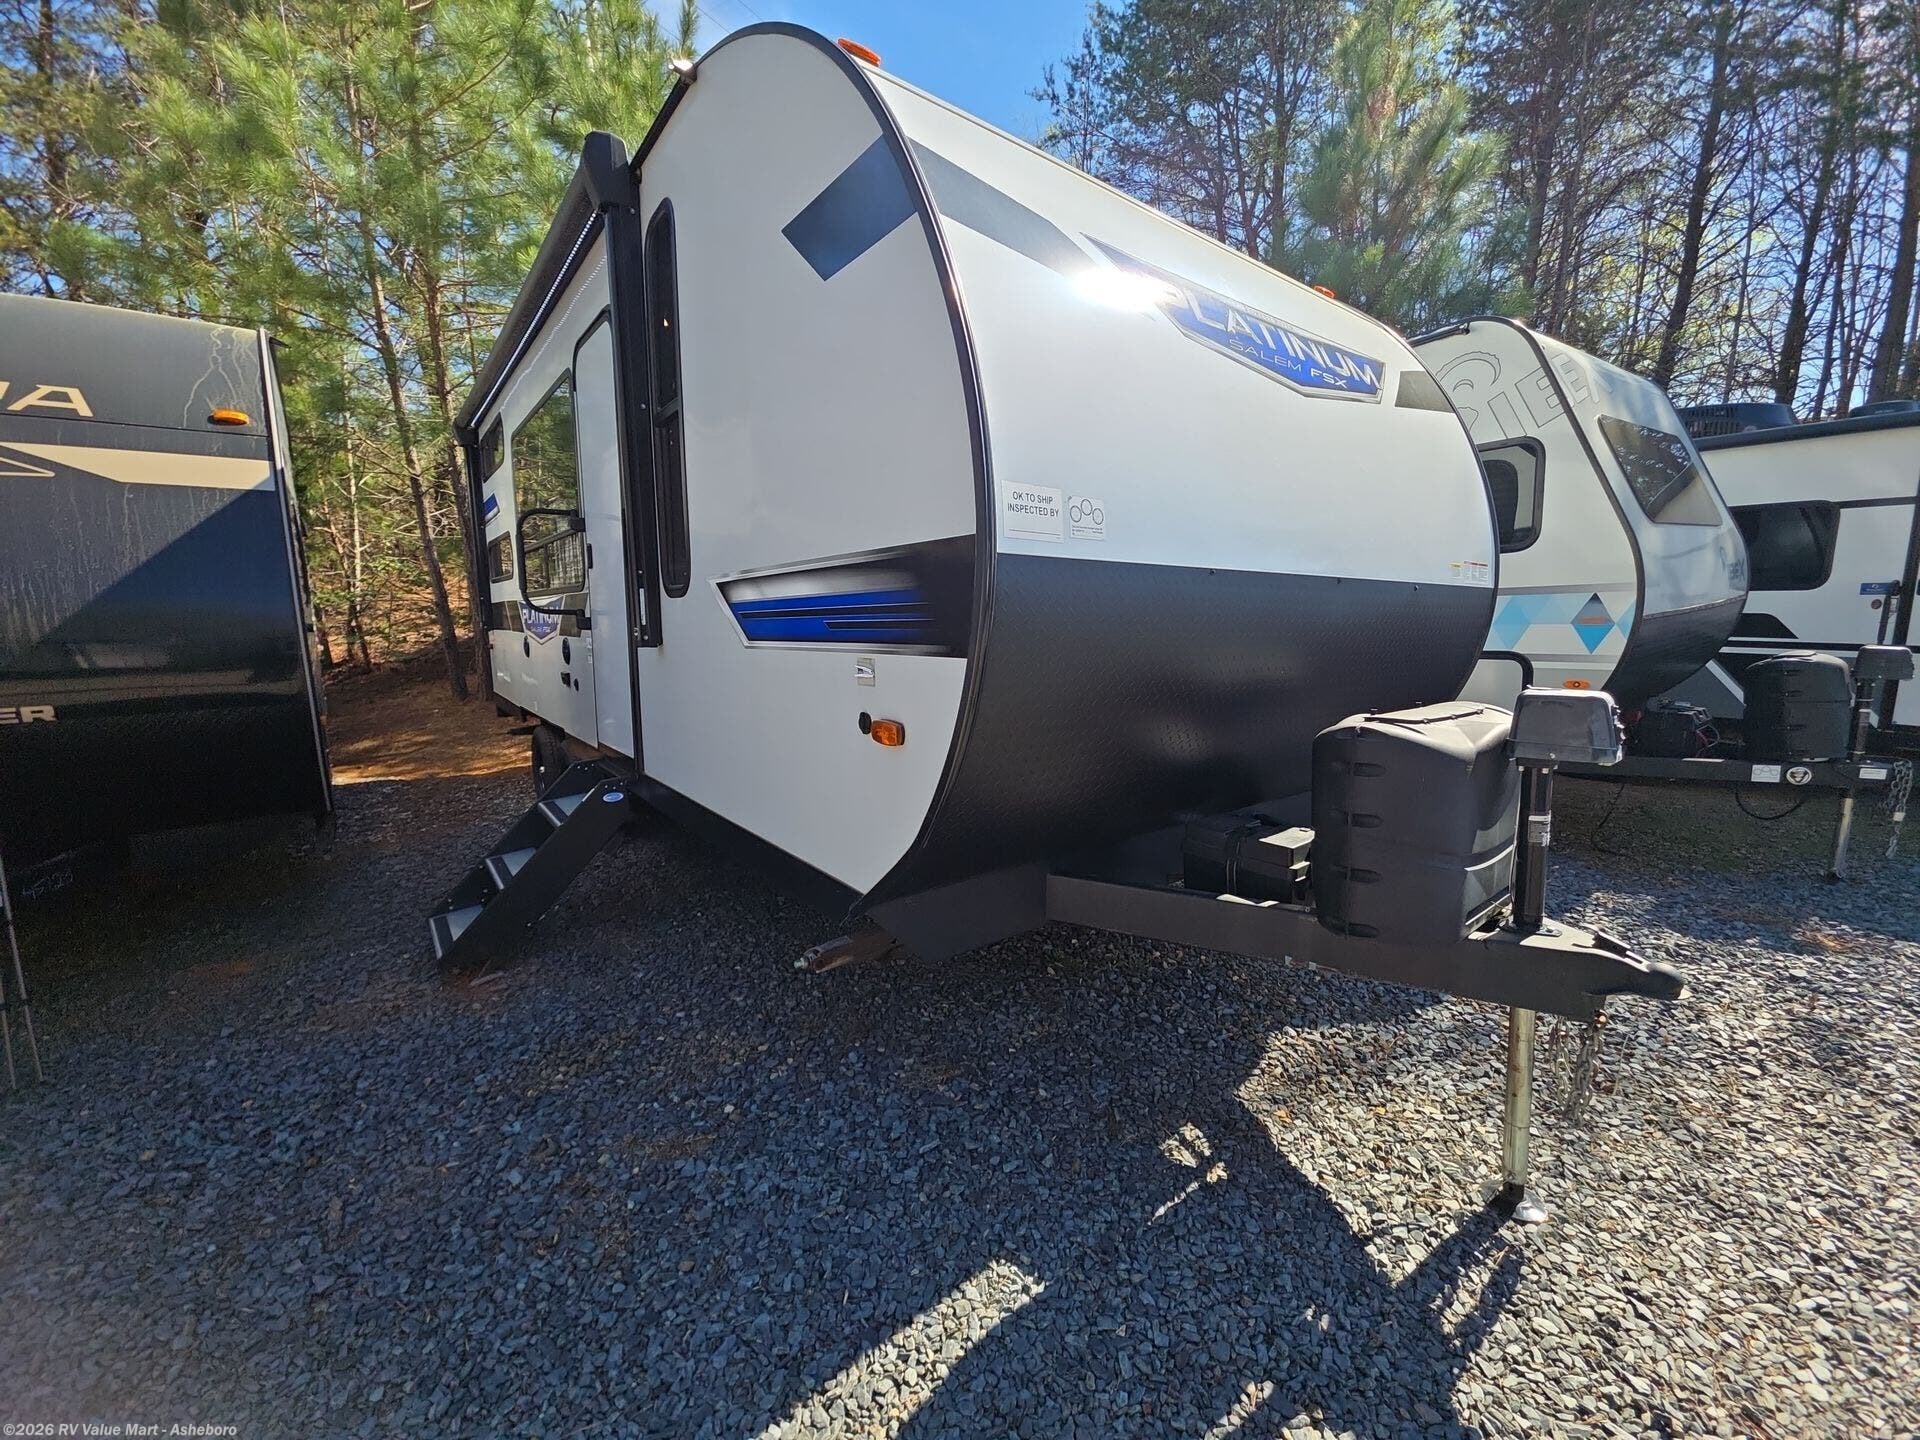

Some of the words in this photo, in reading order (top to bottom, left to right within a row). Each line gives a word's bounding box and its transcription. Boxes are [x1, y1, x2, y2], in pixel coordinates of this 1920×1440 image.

[1228, 339, 1301, 372] SALEM
[1310, 368, 1347, 389] FSX
[1012, 491, 1024, 501] OK
[1025, 493, 1035, 503] TO
[1037, 495, 1053, 505] SHIP
[1008, 503, 1048, 516] INSPECTED
[1050, 508, 1059, 517] BY
